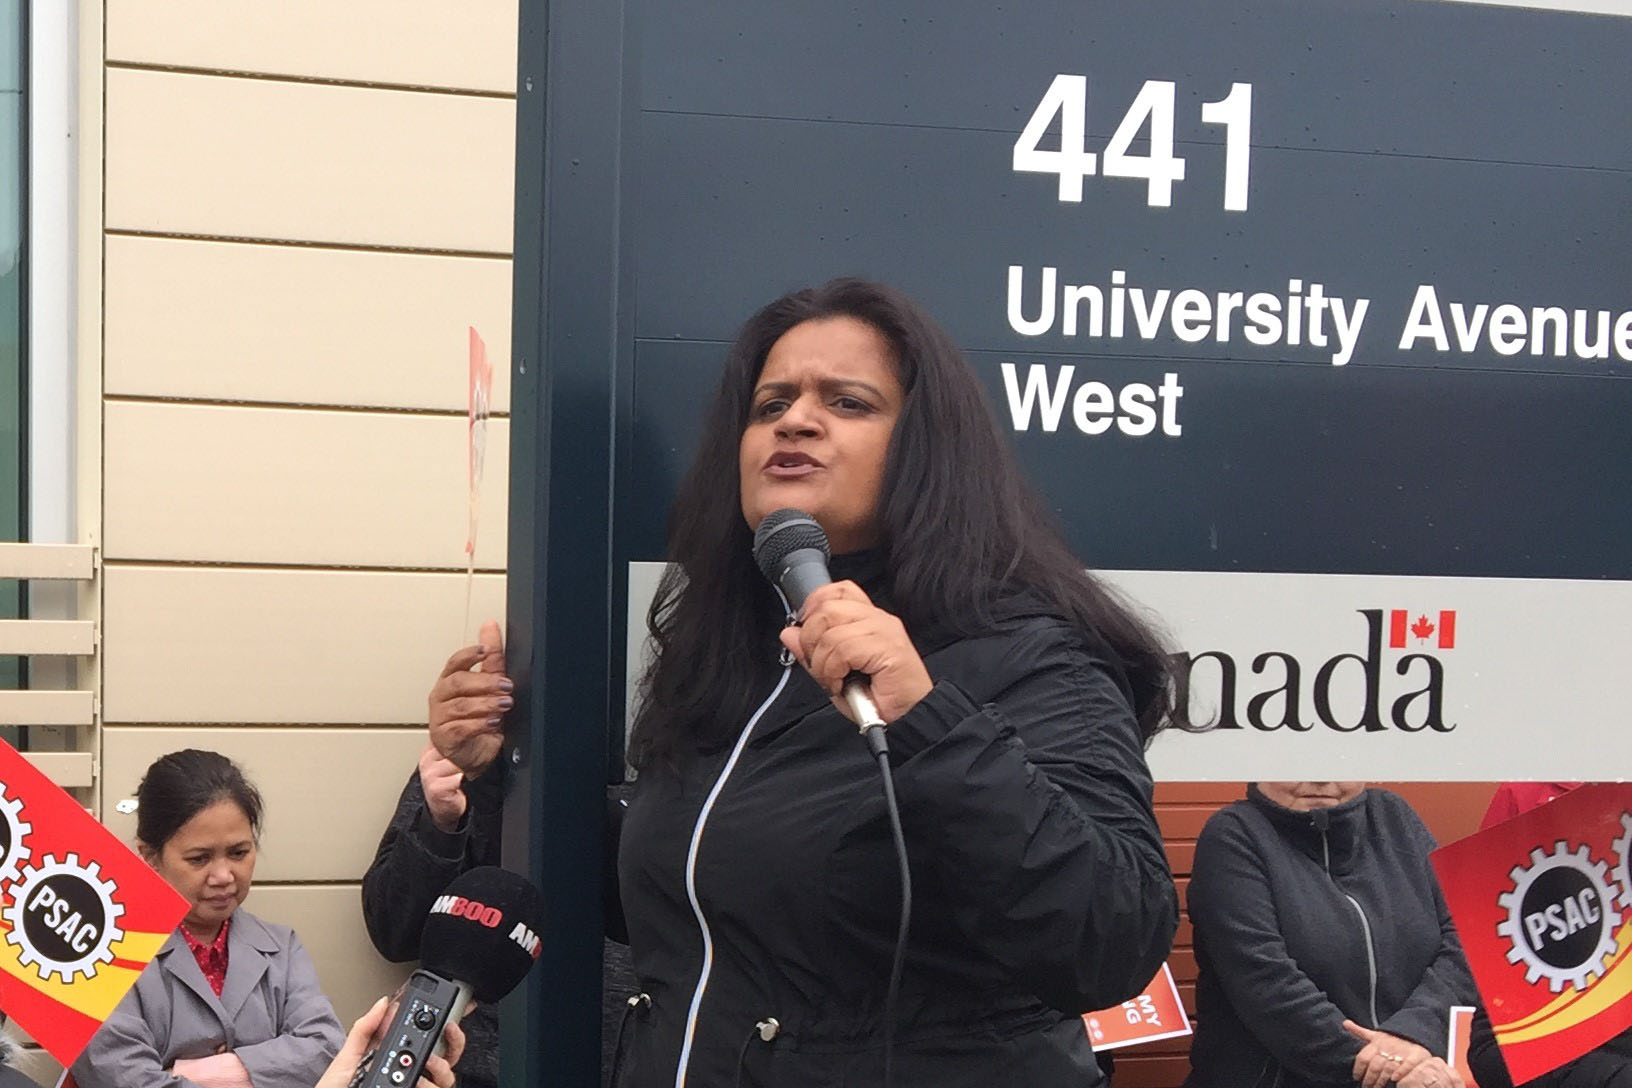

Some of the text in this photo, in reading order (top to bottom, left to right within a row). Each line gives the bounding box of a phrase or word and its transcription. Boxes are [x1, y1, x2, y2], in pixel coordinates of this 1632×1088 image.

[1012, 74, 1252, 212] 441
[1006, 265, 1632, 366] University Avenue
[1001, 363, 1184, 437] West
[1165, 609, 1456, 734] nada
[28, 885, 97, 953] PSAC
[1524, 887, 1601, 951] PSAC
[1137, 994, 1162, 1027] MY
